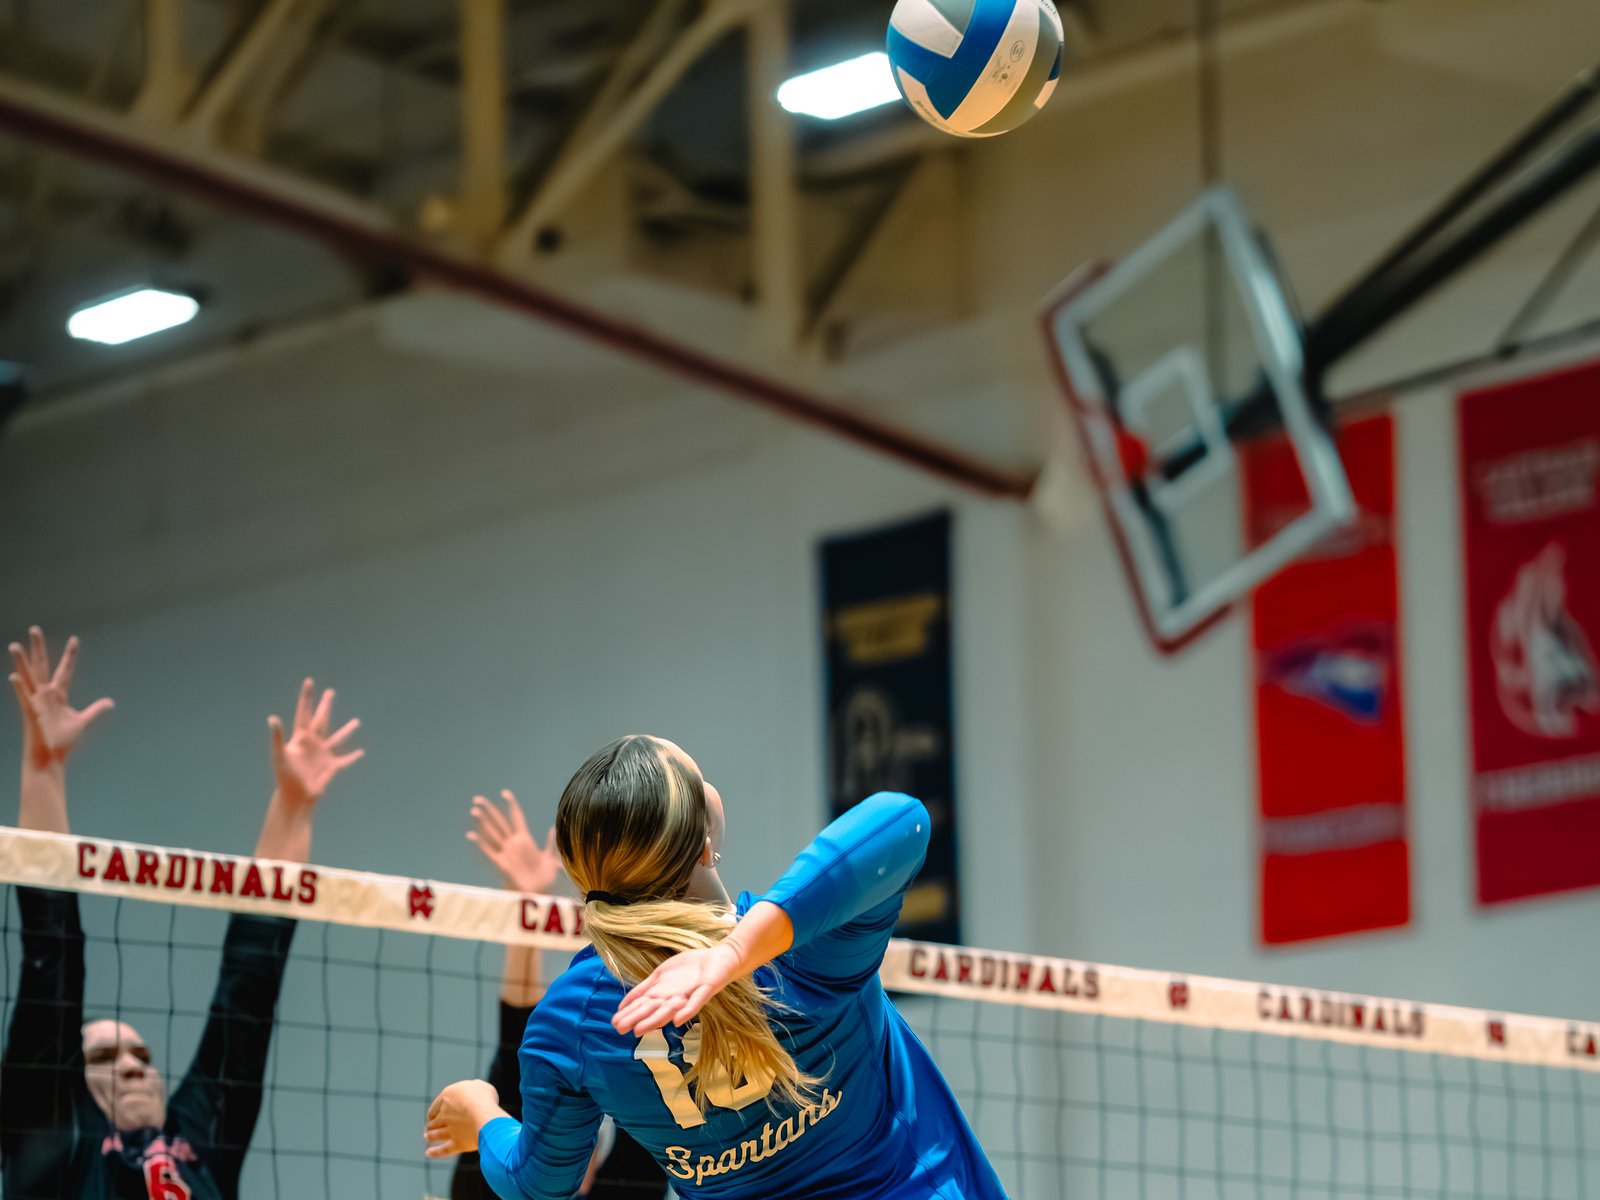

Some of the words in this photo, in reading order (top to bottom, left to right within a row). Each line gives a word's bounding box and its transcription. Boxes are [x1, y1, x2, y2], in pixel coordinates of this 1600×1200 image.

[77, 842, 318, 904] CARDINALS
[908, 947, 1100, 999] CARDINALS
[1256, 988, 1425, 1038] CARDINALS
[665, 1087, 843, 1187] Spartans
